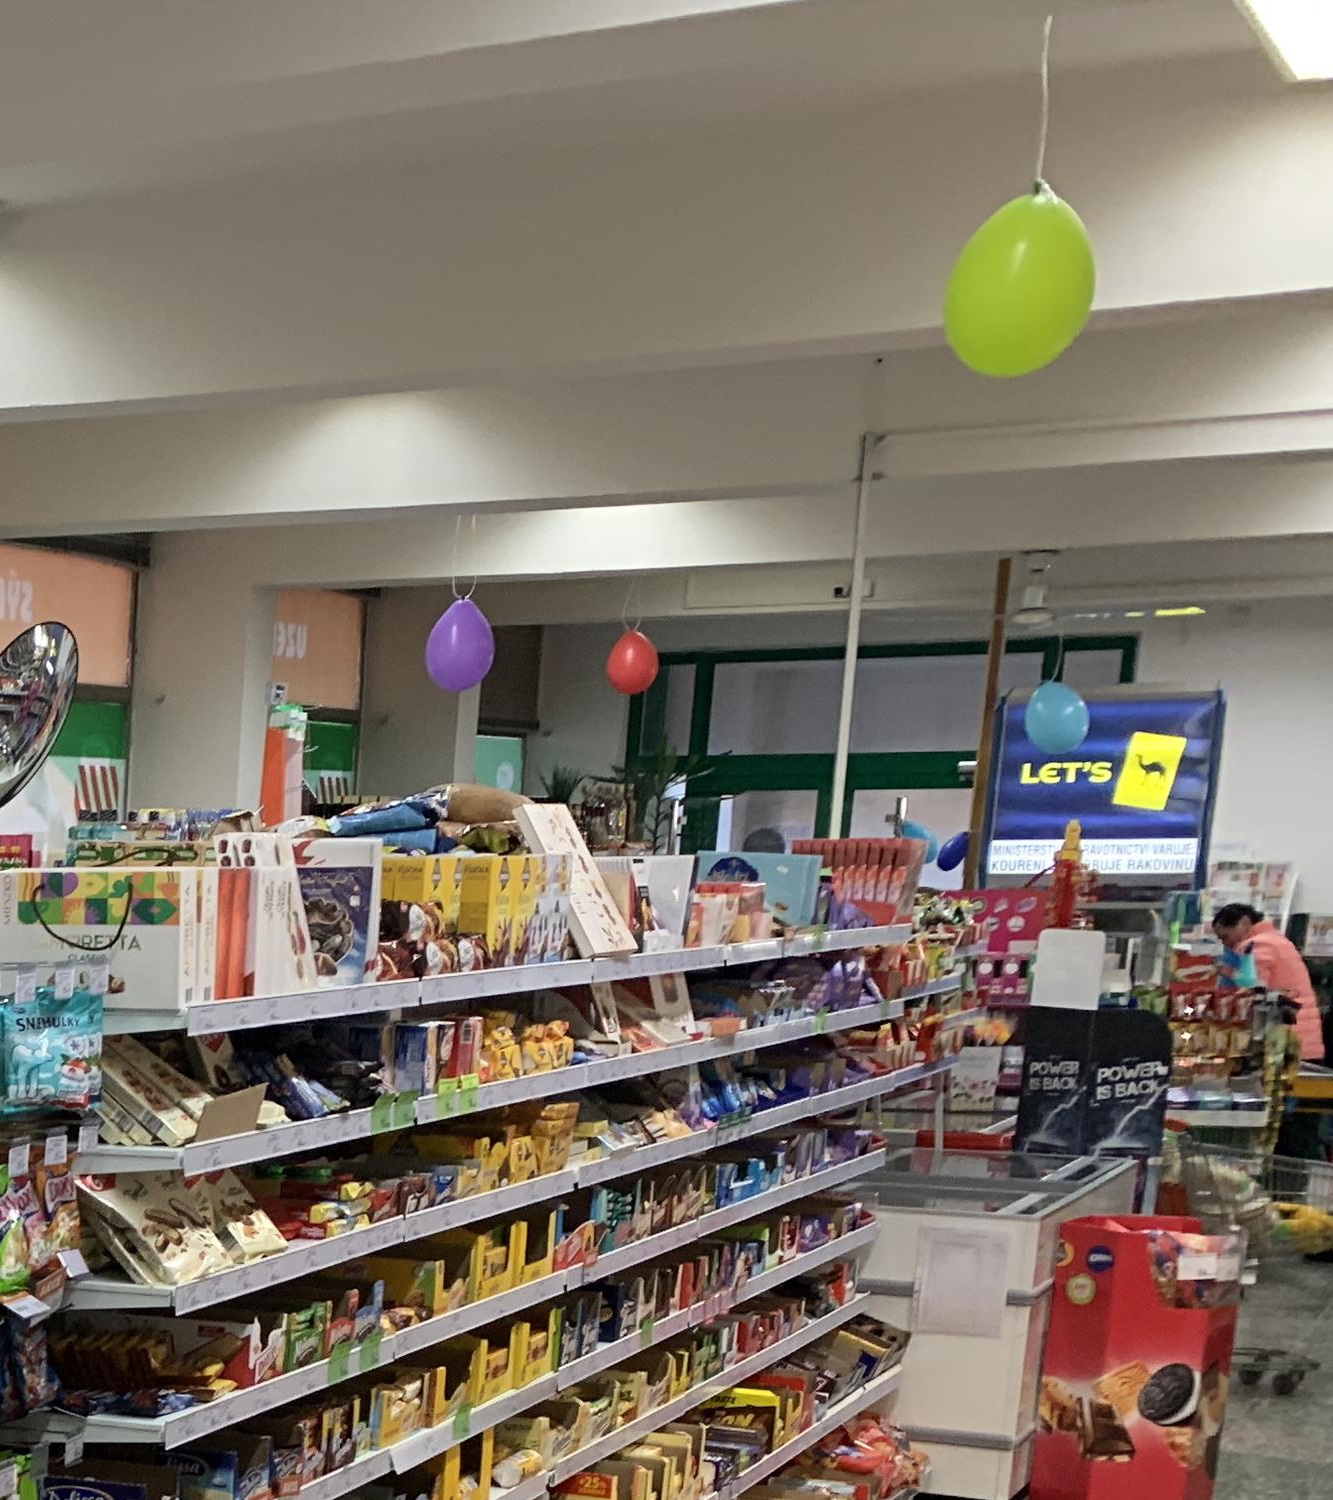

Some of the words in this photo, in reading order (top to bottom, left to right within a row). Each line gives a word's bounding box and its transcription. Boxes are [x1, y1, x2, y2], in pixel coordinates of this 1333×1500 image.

[1030, 1061, 1079, 1076] POWER
[1097, 1063, 1161, 1082] POWER
[1044, 1076, 1077, 1091] BACK
[1097, 1083, 1111, 1099] IS
[1116, 1080, 1160, 1097] BACK
